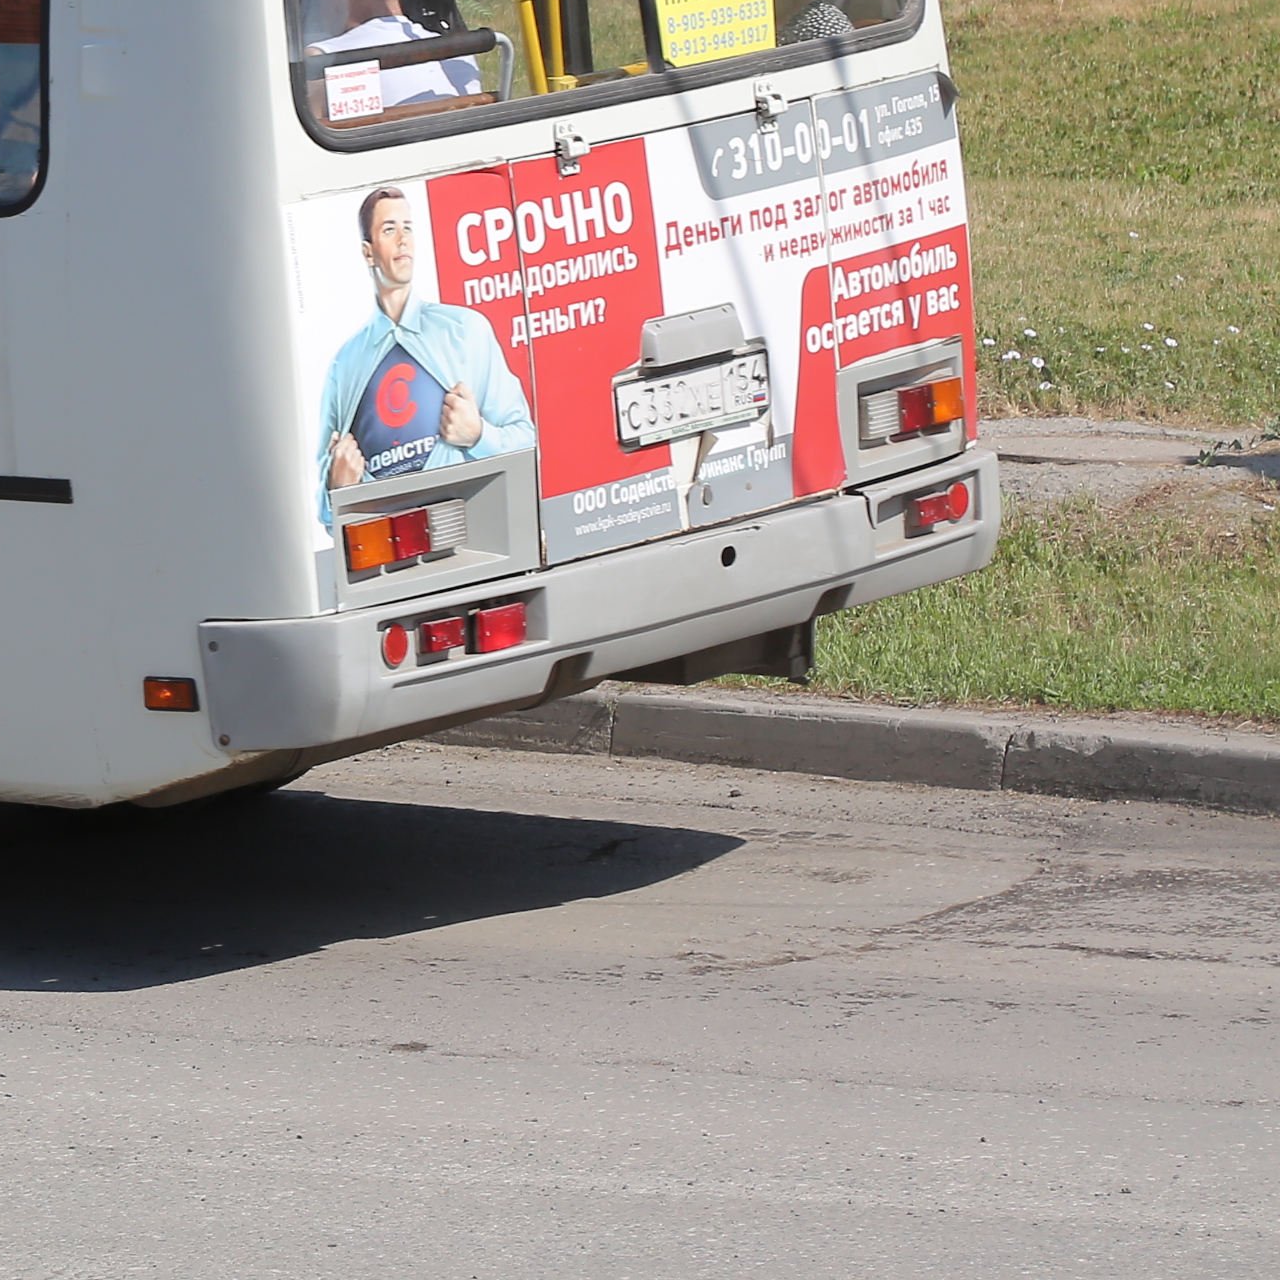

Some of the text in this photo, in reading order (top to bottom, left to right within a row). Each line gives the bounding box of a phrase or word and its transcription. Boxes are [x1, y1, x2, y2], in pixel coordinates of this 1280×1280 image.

[667, 0, 767, 34] 8-905-939-6333
[670, 24, 768, 58] 8-913-948-1917
[331, 96, 381, 116] 341-31-23
[874, 104, 891, 123] ул.
[878, 116, 923, 147] офис 435
[729, 109, 871, 179] 310-00-01
[456, 181, 633, 266] СРОЧНО
[665, 159, 948, 258] Деньги под залог автомобиля
[764, 195, 951, 262] и недвижимости за 1 час
[464, 246, 639, 306] ПОНАДОБИЛИСЬ
[833, 242, 958, 303] Автомобиль
[511, 298, 606, 348] ДЕНЬГИ?
[806, 283, 960, 353] остается у вас
[735, 393, 753, 406] RUS
[365, 434, 439, 473] действ
[573, 488, 606, 514] ООО
[746, 443, 786, 471] Групп
